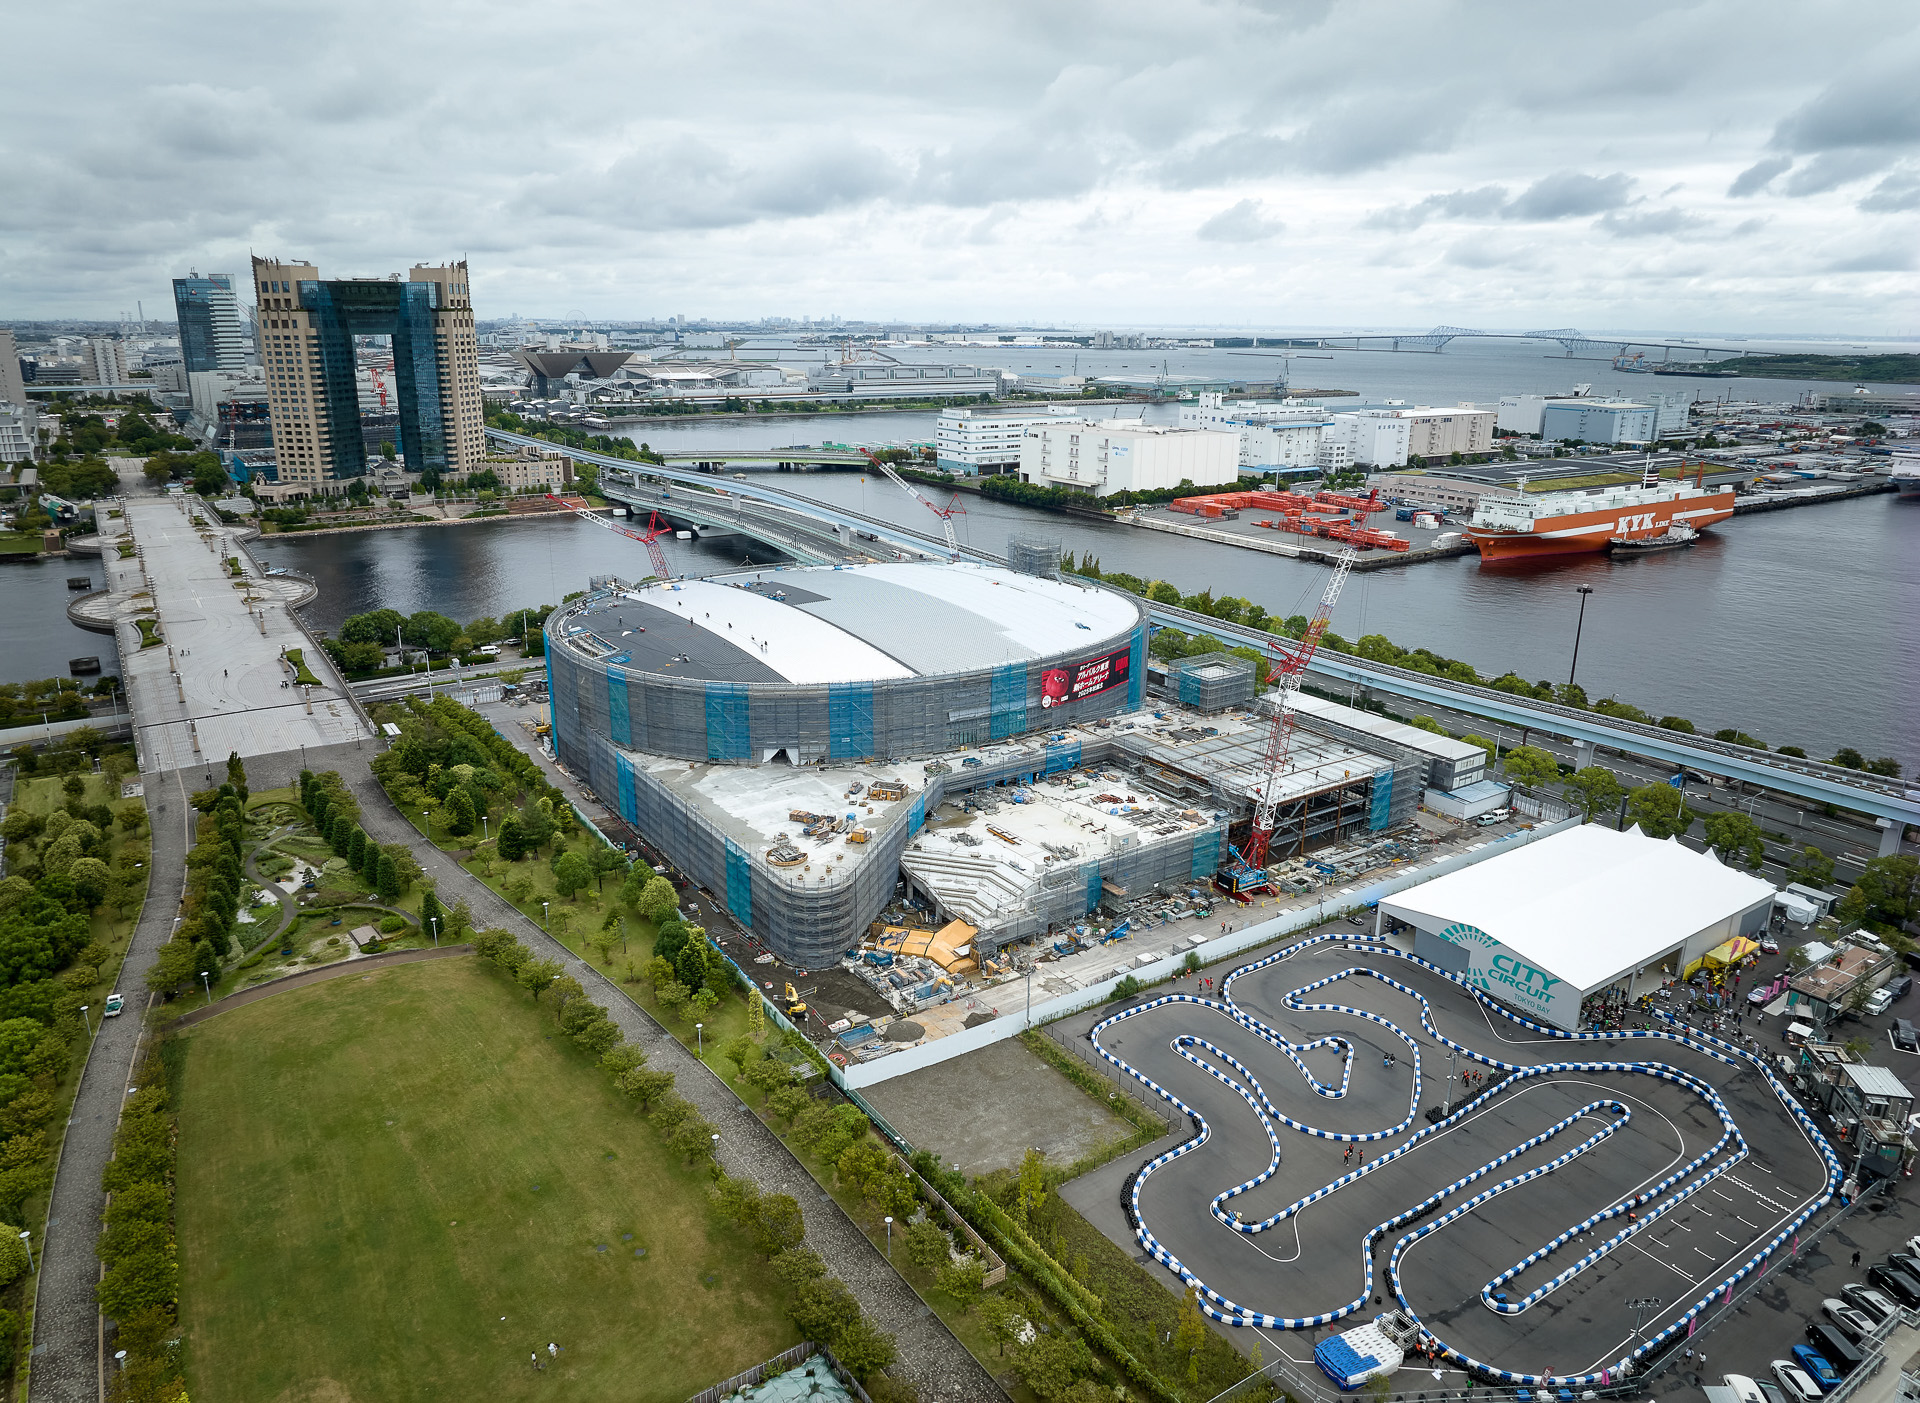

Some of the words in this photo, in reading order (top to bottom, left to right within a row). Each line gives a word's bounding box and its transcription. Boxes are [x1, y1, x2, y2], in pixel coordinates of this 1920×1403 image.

[1616, 512, 1656, 534] KYK
[1655, 519, 1670, 528] LINE
[1488, 968, 1556, 1004] CIRCUIT
[1492, 954, 1561, 992] CITY
[1514, 993, 1535, 1008] TOKYO
[1536, 1004, 1551, 1015] BAY
